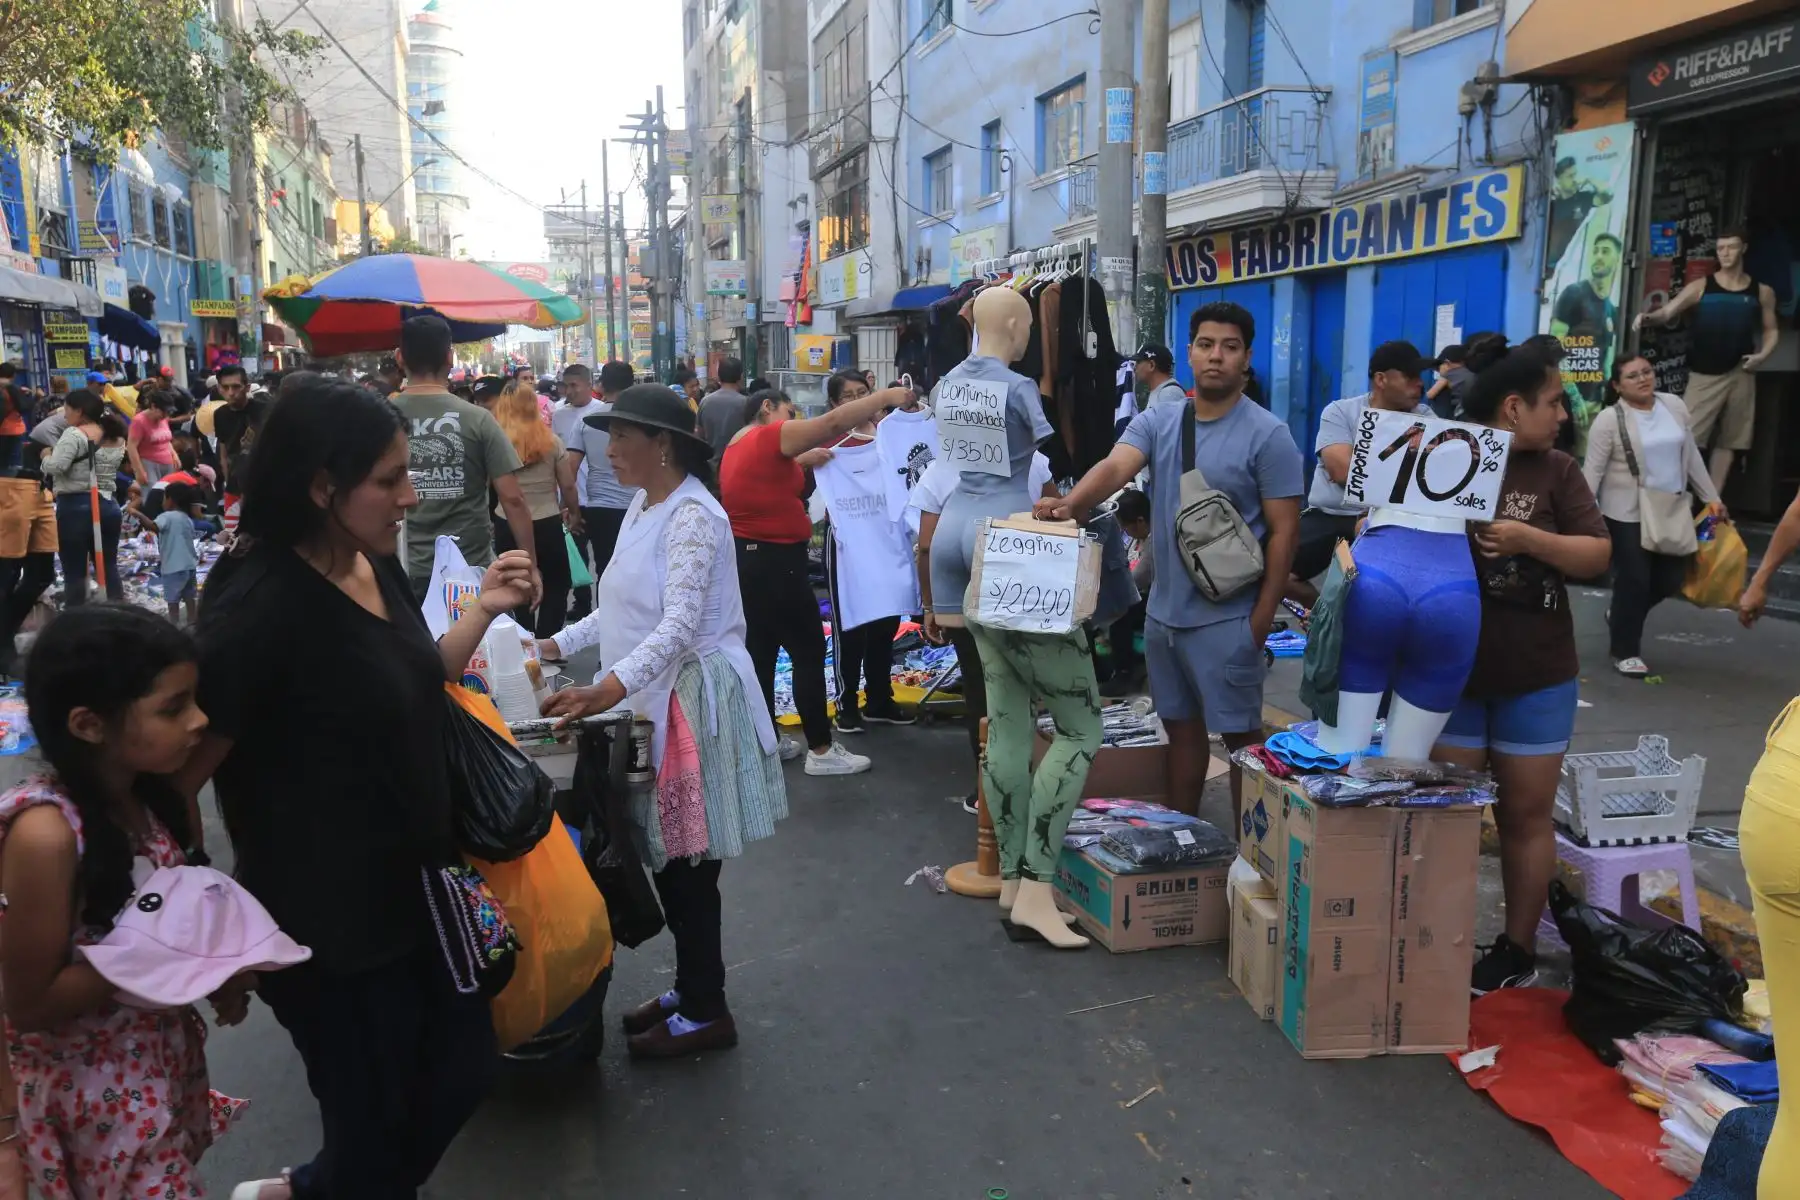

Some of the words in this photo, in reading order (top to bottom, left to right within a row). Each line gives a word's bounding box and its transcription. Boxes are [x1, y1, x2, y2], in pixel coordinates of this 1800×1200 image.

[1674, 25, 1794, 81] RIFF&RAFF
[1167, 238, 1218, 286] LOS
[1231, 173, 1508, 279] FABRICANTES
[1559, 335, 1594, 347] OLOS
[941, 379, 997, 408] Conjunto
[944, 405, 1006, 428] Importado
[424, 466, 465, 481] EARS
[1378, 421, 1481, 504] 10
[1453, 493, 1487, 511] soles
[987, 530, 1064, 556] Leggins
[1152, 923, 1194, 939] FRAGIL
